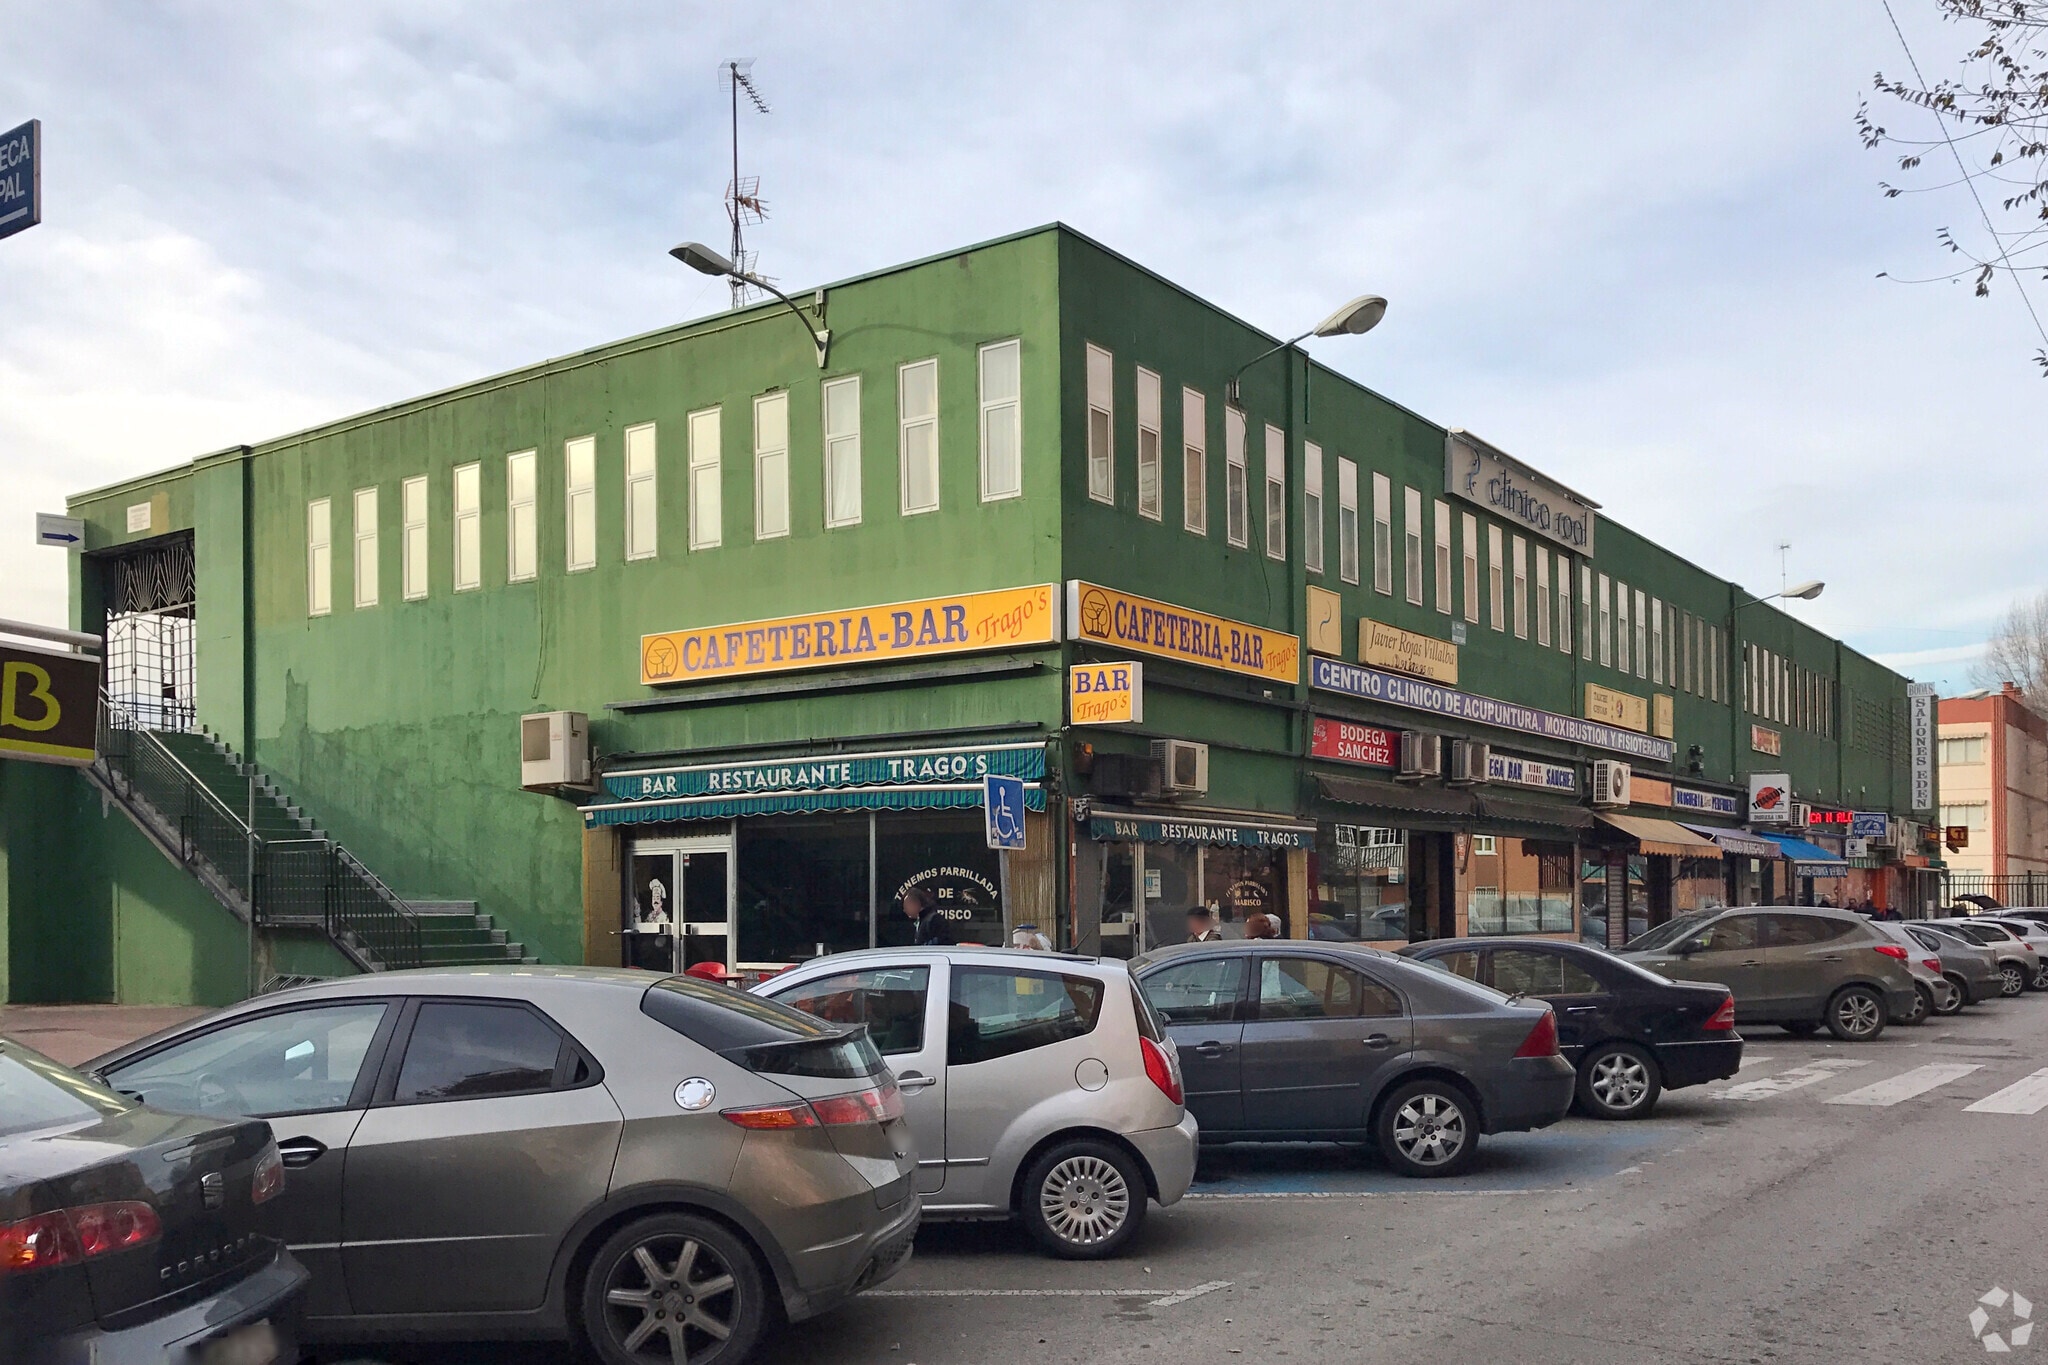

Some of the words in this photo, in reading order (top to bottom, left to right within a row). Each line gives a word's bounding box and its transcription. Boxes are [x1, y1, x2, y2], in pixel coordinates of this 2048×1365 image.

[683, 604, 969, 672] CAFETERIA-BAR
[976, 591, 1047, 643] Trago's
[1115, 600, 1264, 669] CAFETERIA-BAR
[1265, 642, 1297, 673] Trago's
[1369, 624, 1397, 650] Javier
[1399, 631, 1422, 660] Rojas
[1424, 639, 1454, 665] Villalba
[1075, 669, 1130, 693] BAR
[1909, 683, 1934, 696] BODAS
[1, 661, 61, 731] B
[1077, 694, 1127, 720] Trago's
[1319, 662, 1381, 696] CENTRO
[1387, 679, 1441, 710] CLINICO
[1445, 692, 1461, 714] DE
[1545, 715, 1607, 745] MOXIBUSTION
[1610, 731, 1617, 747] Y
[1618, 733, 1669, 759] FISIOTERAPIA
[1340, 725, 1387, 746] BODEGA
[1916, 699, 1927, 765] SALONES
[1338, 742, 1389, 763] SANCHEZ
[642, 775, 677, 794] BAR
[709, 763, 851, 790] RESTAURANTE
[1489, 759, 1504, 777] EGA
[1508, 761, 1522, 780] BAR
[1546, 769, 1575, 788] SANCHEZ
[1917, 771, 1928, 808] EDEN
[1115, 822, 1139, 836] BAR
[1161, 823, 1238, 842] RESTAURANTE
[894, 868, 937, 901] TENEMOS
[941, 866, 998, 900] PARRILLADA
[938, 887, 954, 899] DE
